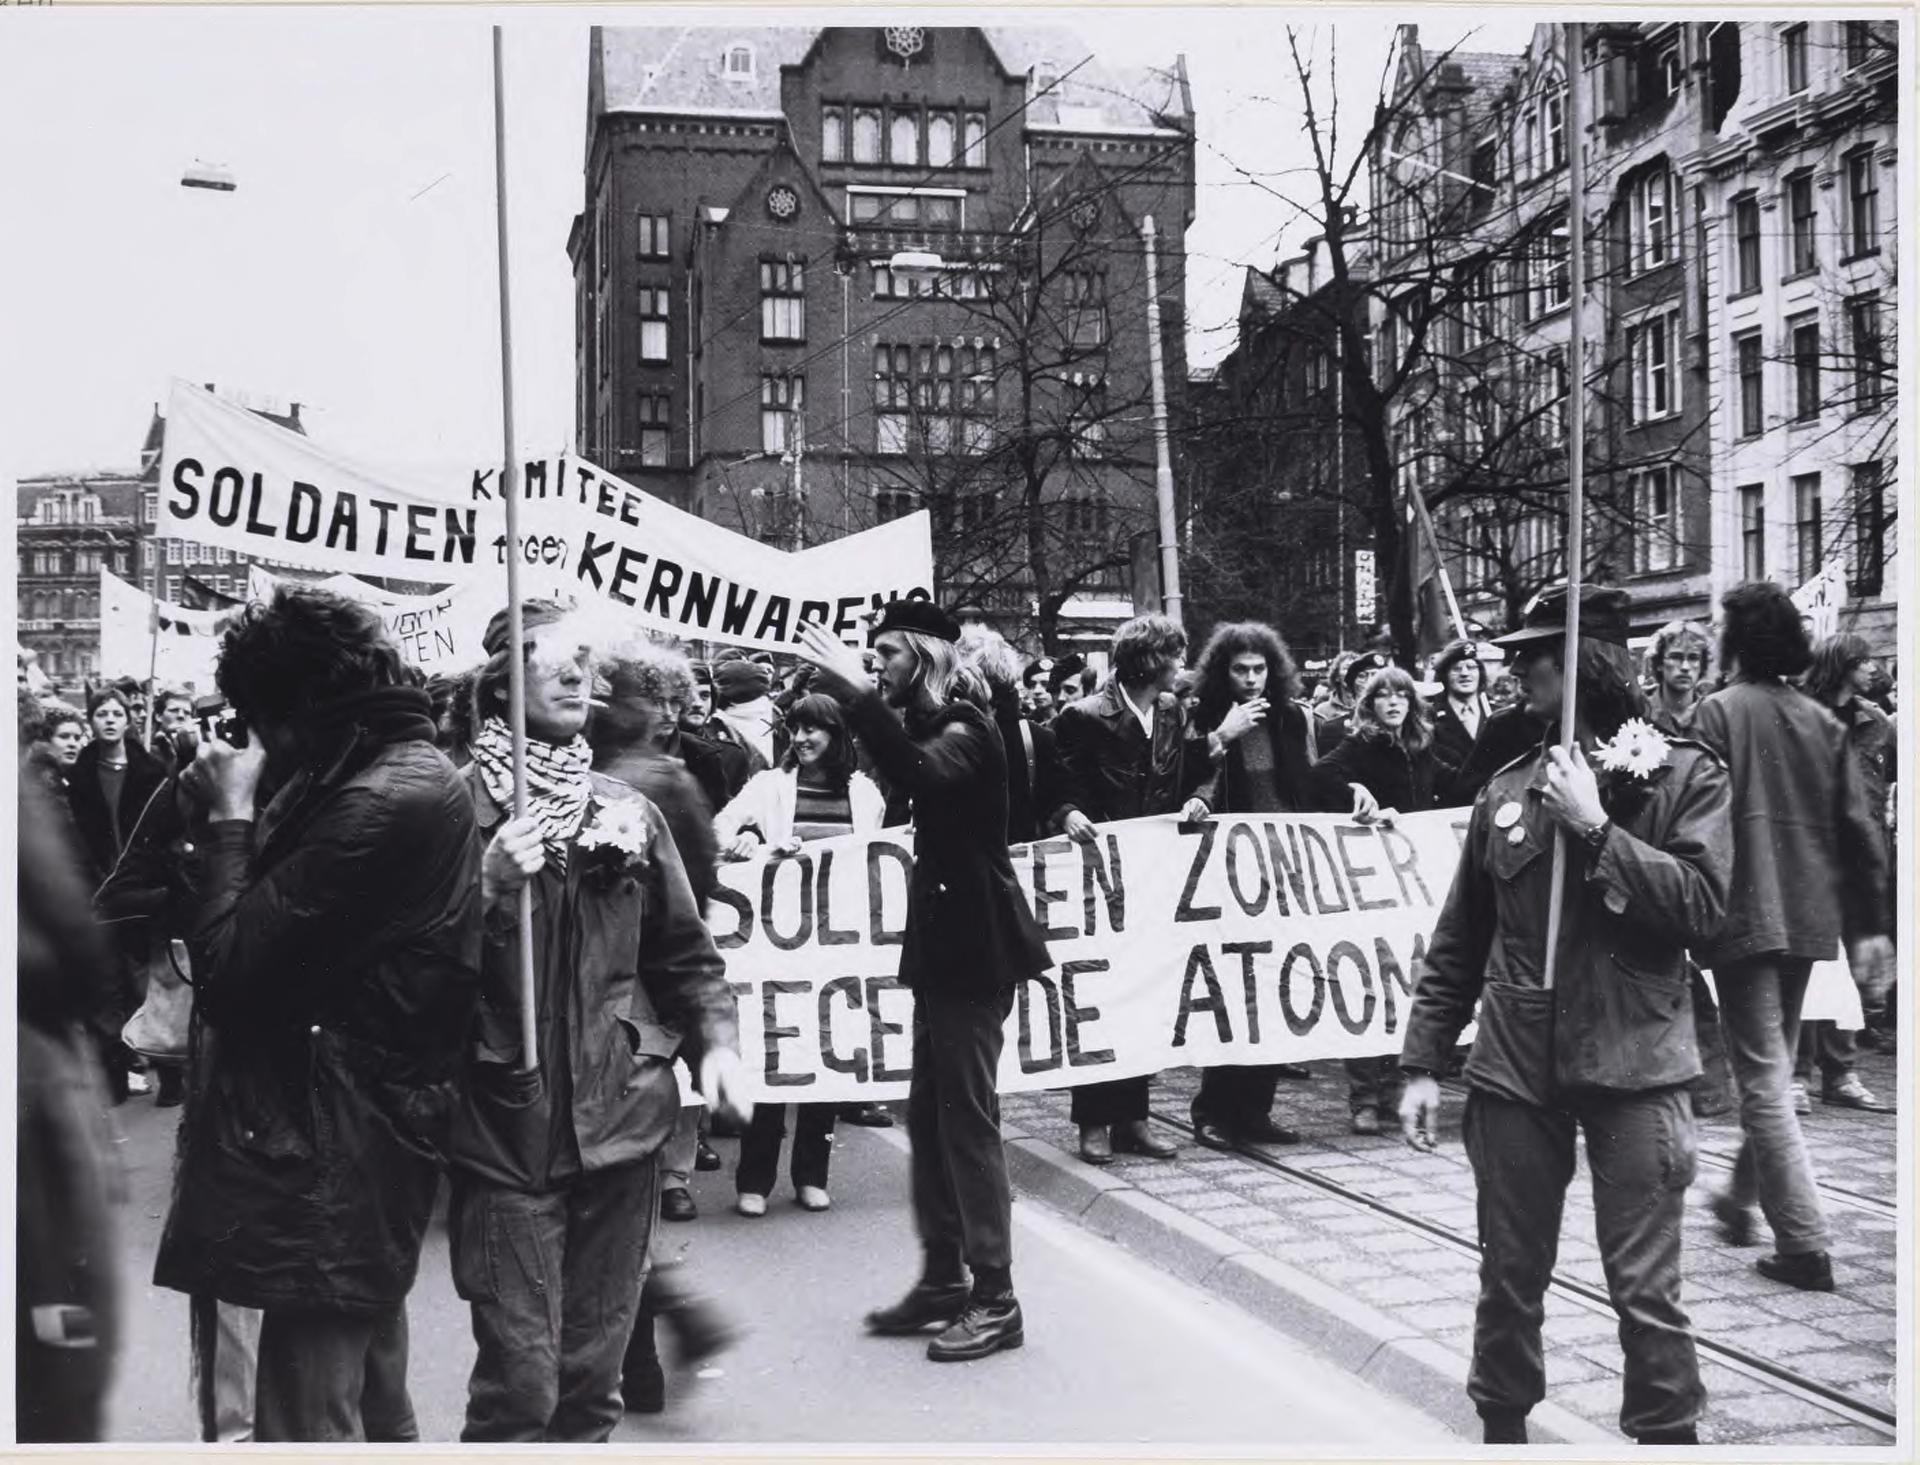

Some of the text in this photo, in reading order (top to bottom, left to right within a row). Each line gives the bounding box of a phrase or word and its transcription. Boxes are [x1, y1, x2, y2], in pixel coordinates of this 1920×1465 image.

[168, 458, 476, 564] SOLDATEN
[706, 821, 1434, 950] SOLDEN ZONDER
[1017, 959, 1116, 1074] DE
